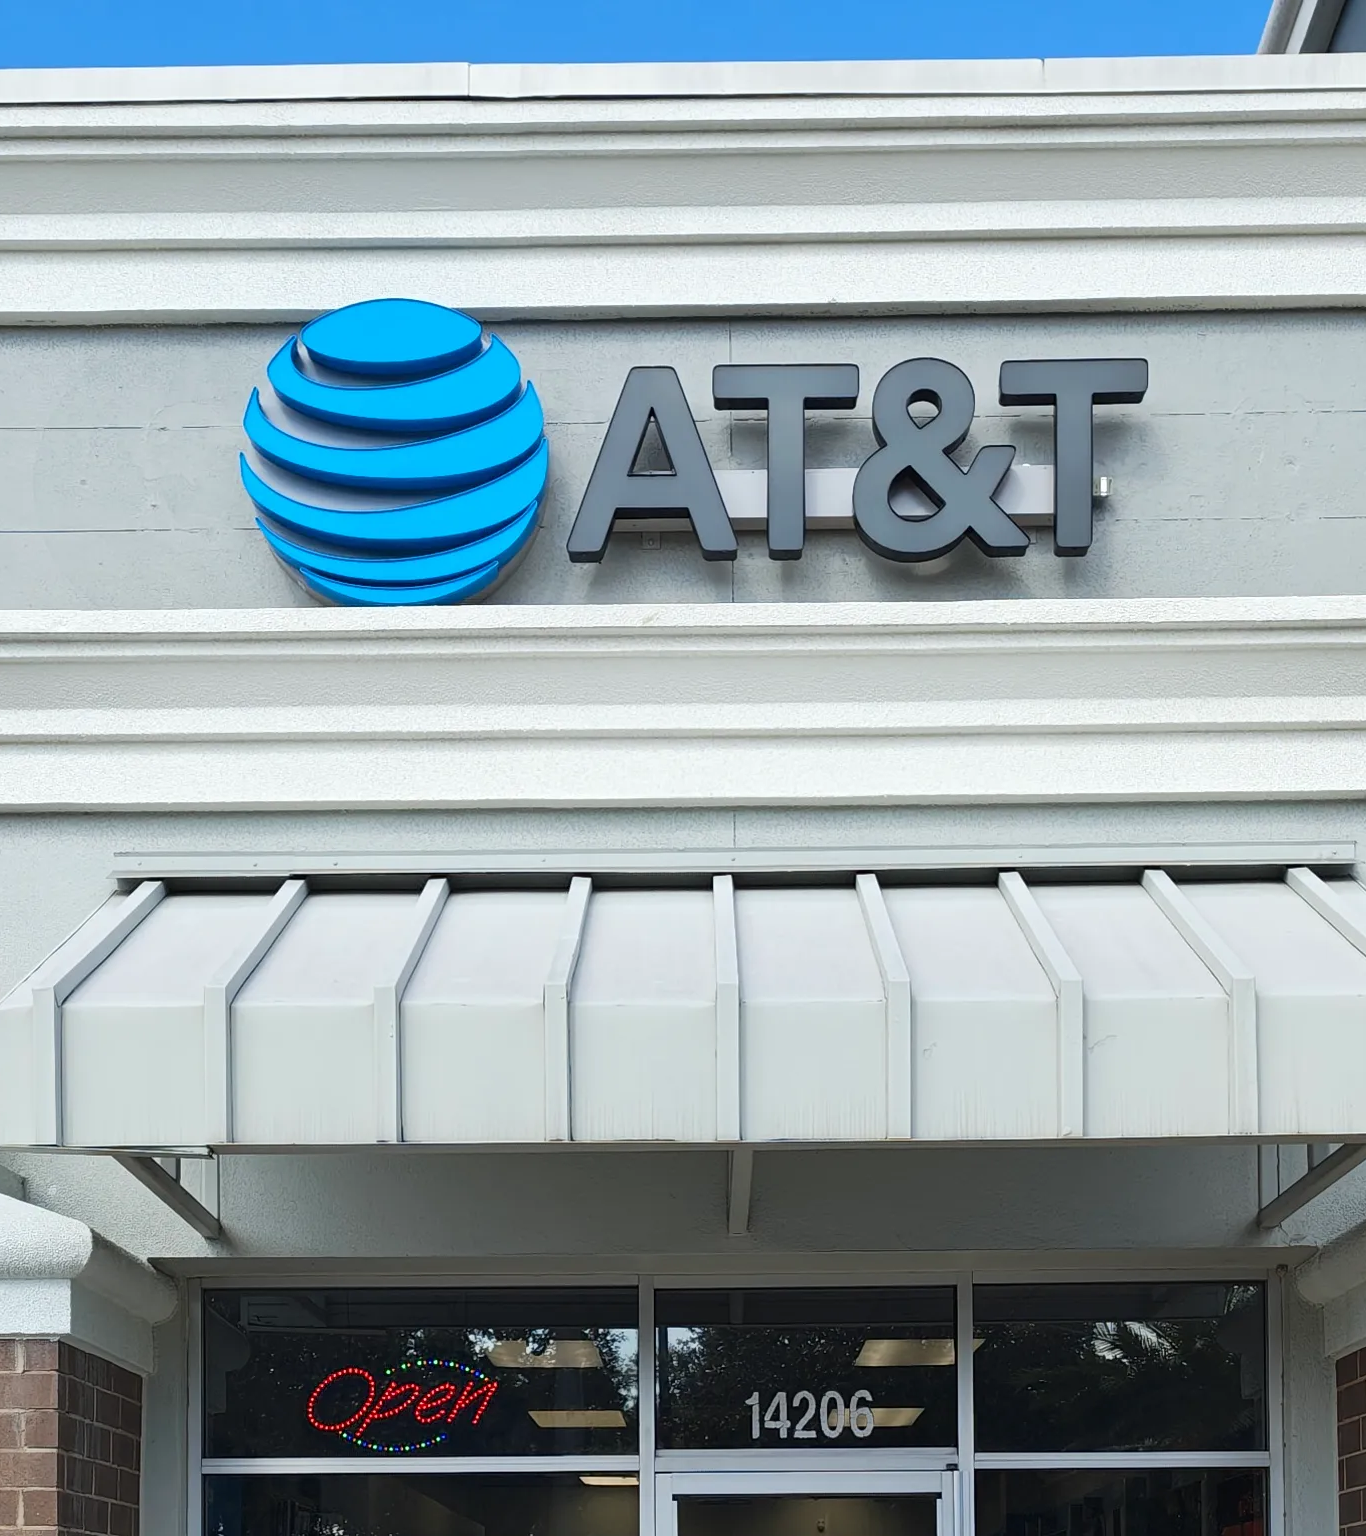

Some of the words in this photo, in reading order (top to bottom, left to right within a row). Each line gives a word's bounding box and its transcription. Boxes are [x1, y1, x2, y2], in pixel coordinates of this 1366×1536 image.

[566, 356, 1149, 564] AT&T
[306, 1365, 500, 1438] Open
[744, 1389, 875, 1439] 14206
